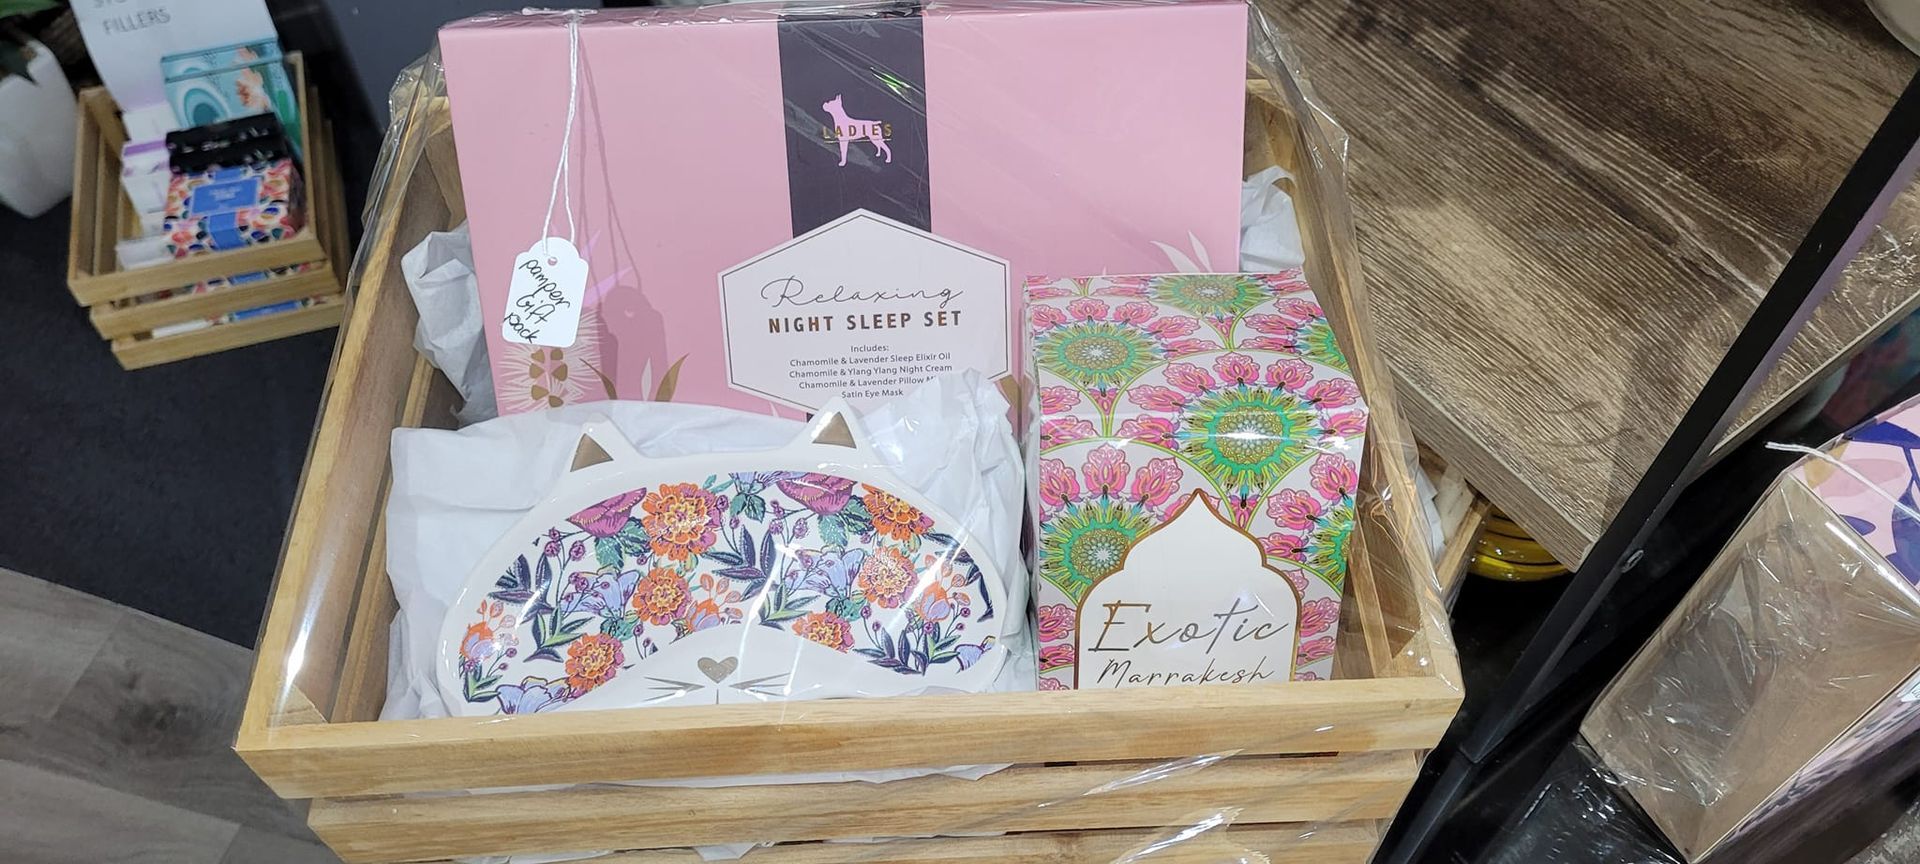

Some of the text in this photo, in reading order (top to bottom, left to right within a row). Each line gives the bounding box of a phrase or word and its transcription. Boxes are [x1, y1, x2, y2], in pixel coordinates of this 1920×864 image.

[102, 7, 171, 35] FILLERS
[822, 124, 893, 139] LADIES
[518, 259, 571, 308] pamper
[760, 275, 964, 308] Relaxing
[768, 310, 962, 334] NIGHT SLEEP SET
[850, 345, 890, 353] Includes:
[789, 352, 951, 367] Chamomile & Lavender Sleep Elixir Oil
[789, 364, 953, 379] Chamomile & Ylang Ylang Night Cream
[799, 380, 848, 390] Chamomile
[849, 379, 856, 387] &
[857, 377, 897, 387] Lavender
[898, 375, 924, 385] Pillow
[841, 387, 904, 399] Satin Eye Mask
[1088, 597, 1289, 654] Exotic
[1096, 655, 1275, 688] Marrakesh
